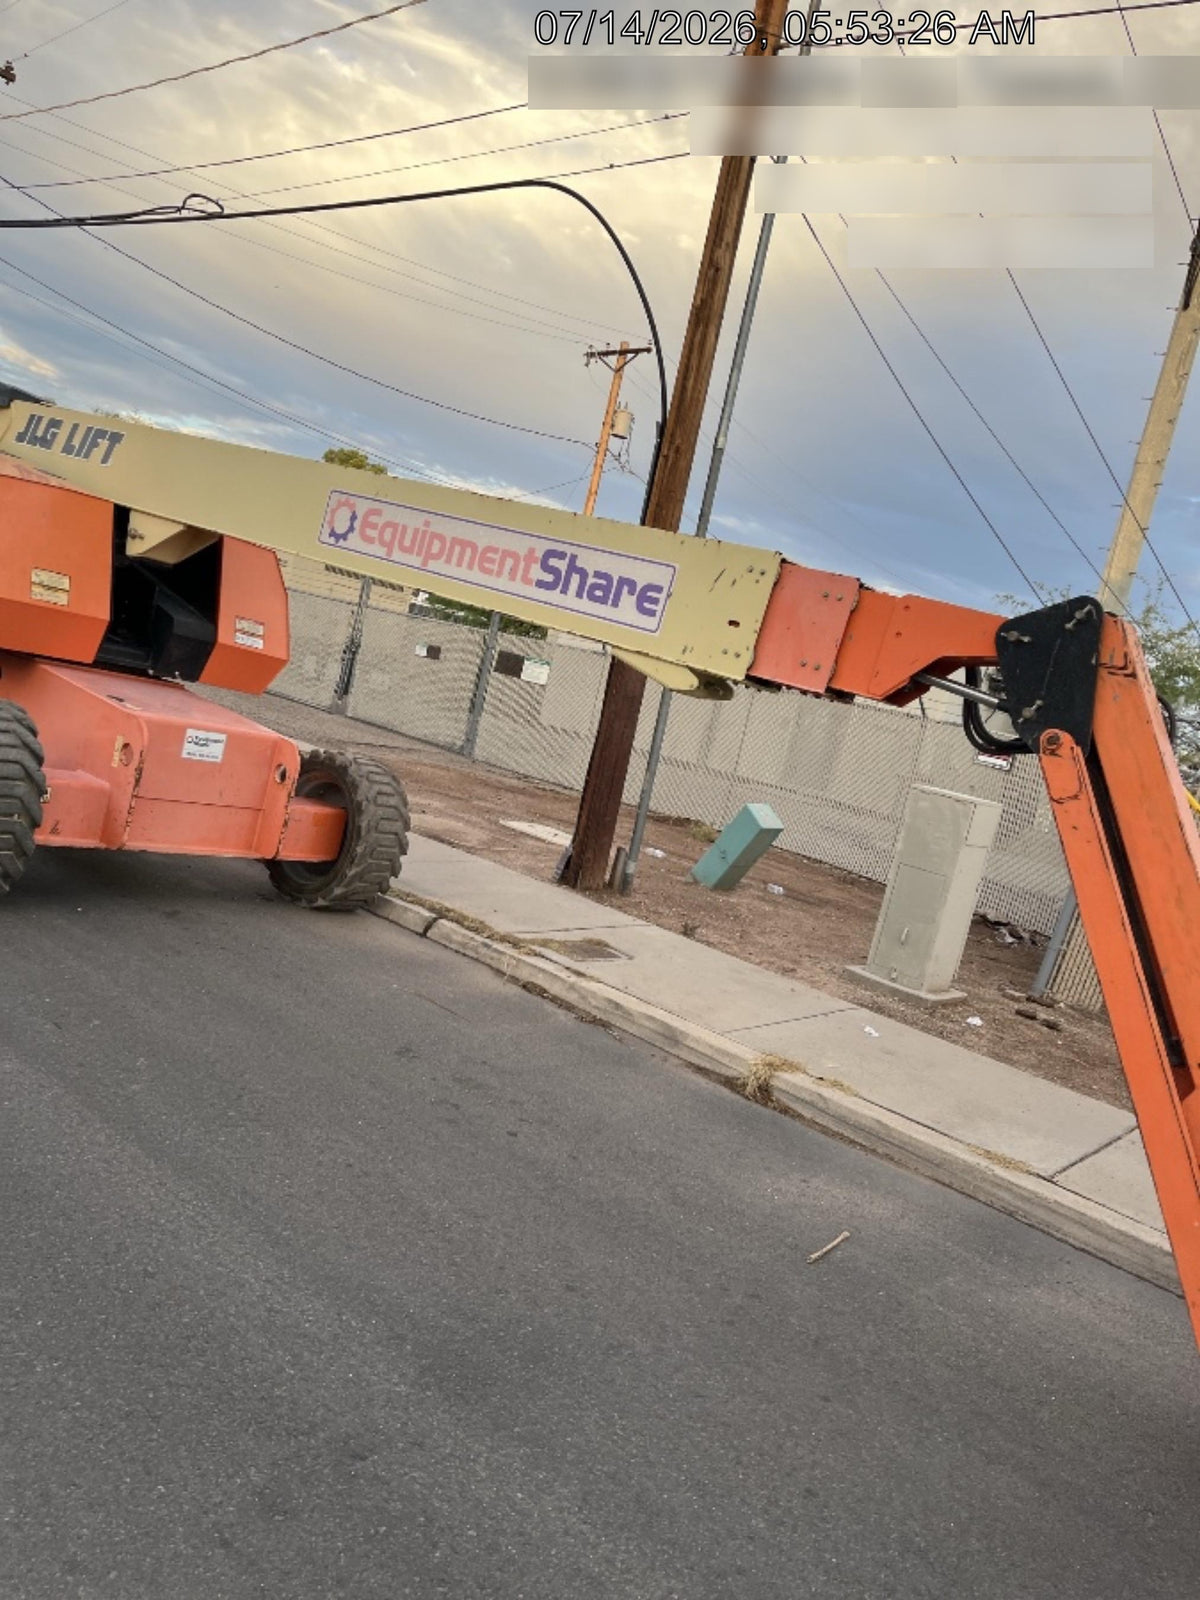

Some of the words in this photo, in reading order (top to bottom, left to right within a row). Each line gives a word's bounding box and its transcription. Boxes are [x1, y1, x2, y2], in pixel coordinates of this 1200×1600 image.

[15, 413, 64, 450] JLG
[60, 422, 125, 466] LIFT
[358, 508, 664, 617] EquipmentShare
